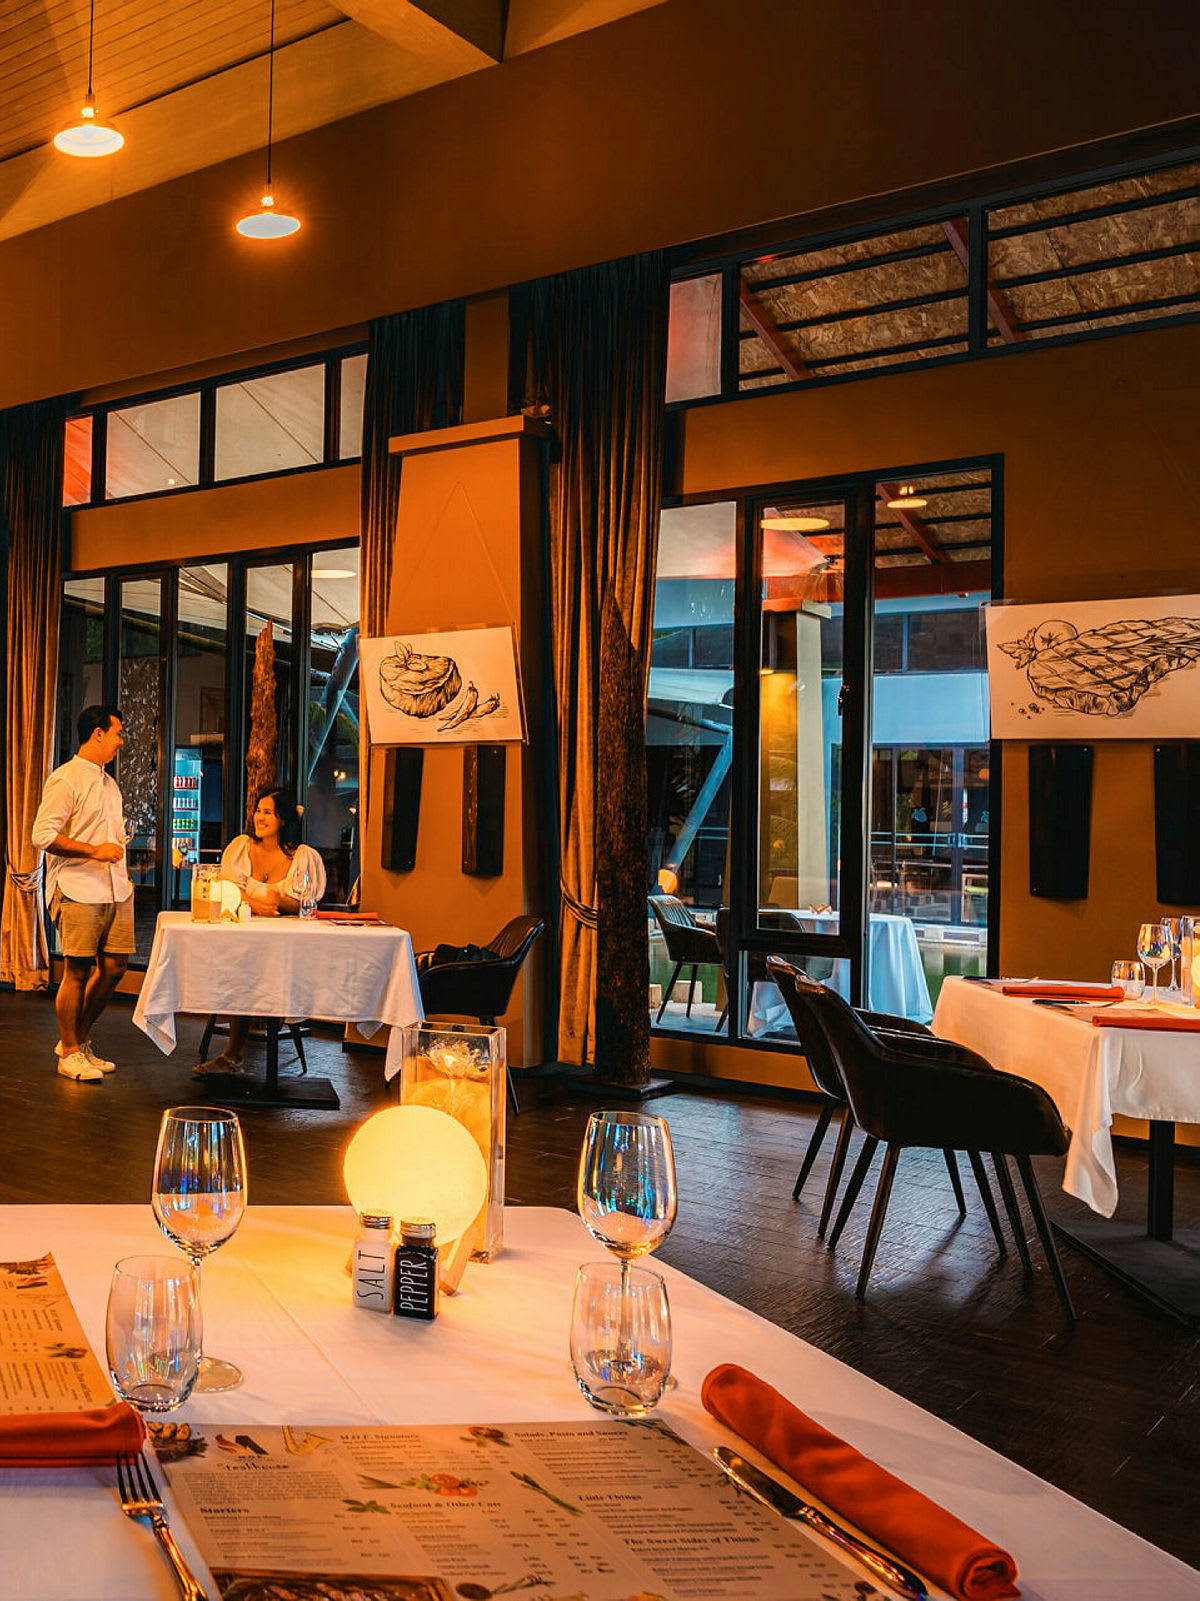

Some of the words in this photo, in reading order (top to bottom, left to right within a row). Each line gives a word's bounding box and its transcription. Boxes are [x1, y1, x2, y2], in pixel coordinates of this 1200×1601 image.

[357, 1250, 385, 1300] SALT
[400, 1260, 428, 1312] PEPPER
[624, 1537, 645, 1545] The
[709, 1536, 721, 1545] of
[722, 1535, 760, 1545] Things
